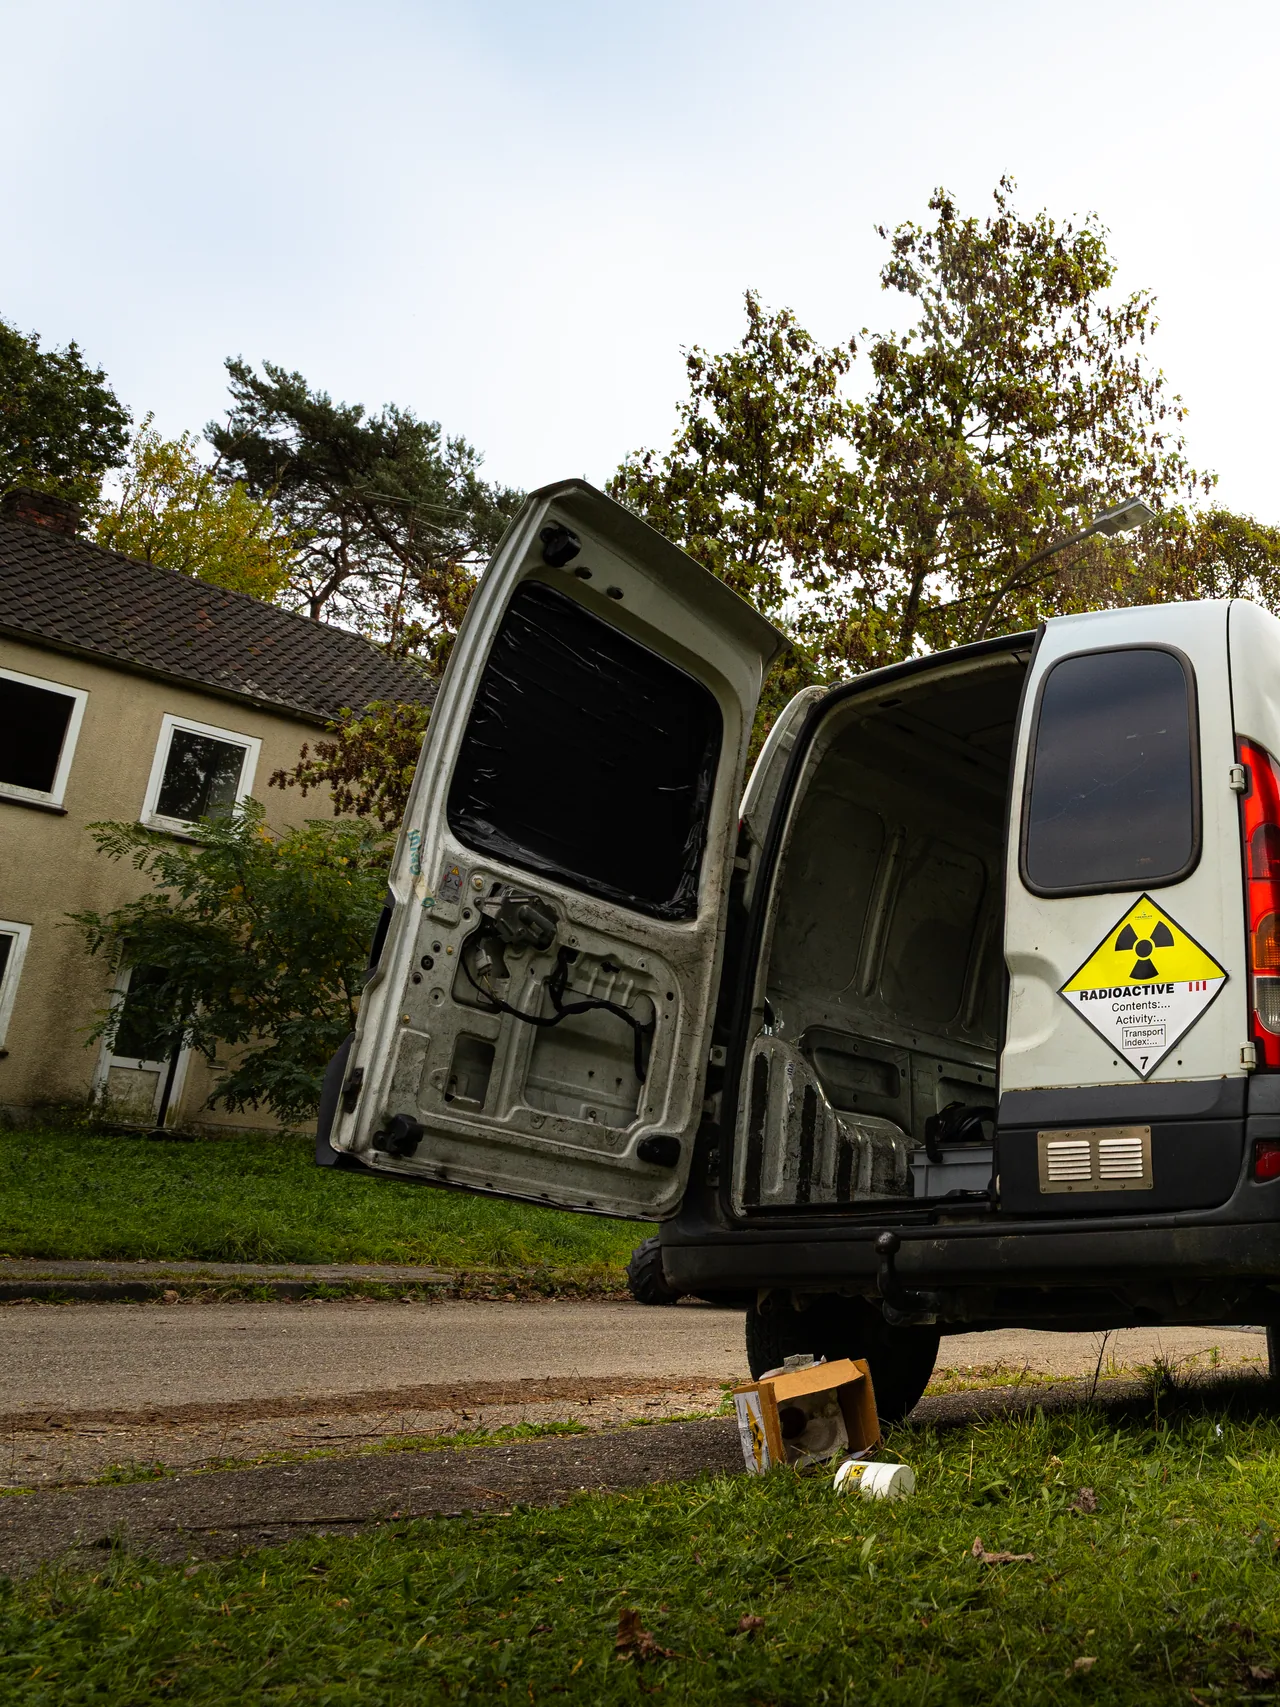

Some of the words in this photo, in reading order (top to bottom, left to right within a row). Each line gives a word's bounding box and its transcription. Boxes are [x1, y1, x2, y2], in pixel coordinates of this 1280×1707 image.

[1080, 983, 1175, 1001] RADIOACTIVE
[1124, 1027, 1164, 1039] Transport
[1140, 1056, 1149, 1070] 7
